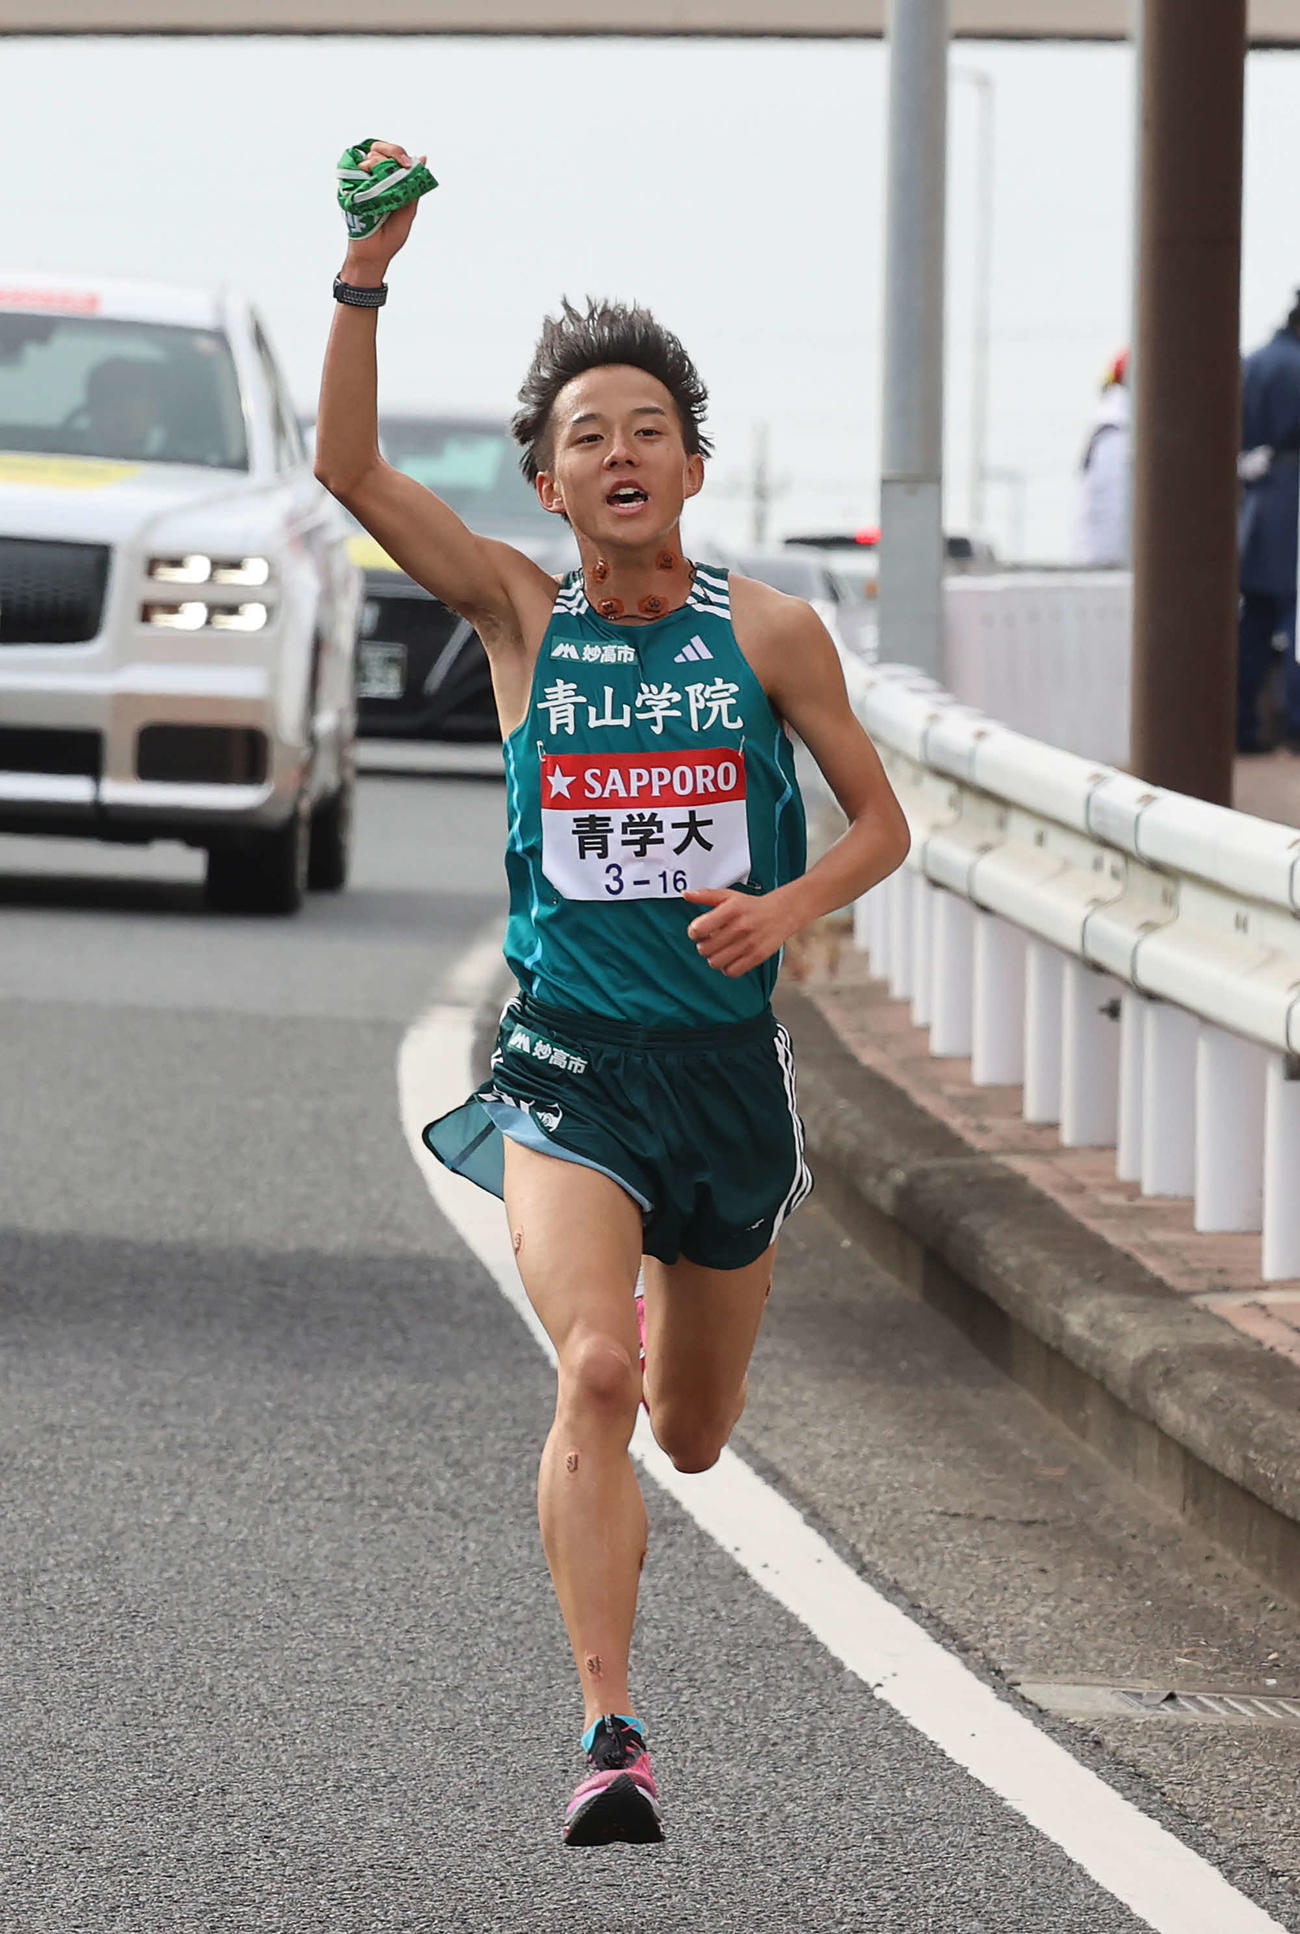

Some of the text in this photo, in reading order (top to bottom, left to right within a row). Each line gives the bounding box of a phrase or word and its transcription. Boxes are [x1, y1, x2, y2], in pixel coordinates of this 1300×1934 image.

[582, 644, 636, 664] 妙高市
[537, 677, 744, 736] 青山学院
[583, 761, 737, 799] SAPPORO
[571, 810, 714, 860] 青学大
[532, 1039, 589, 1074] 妙高市
